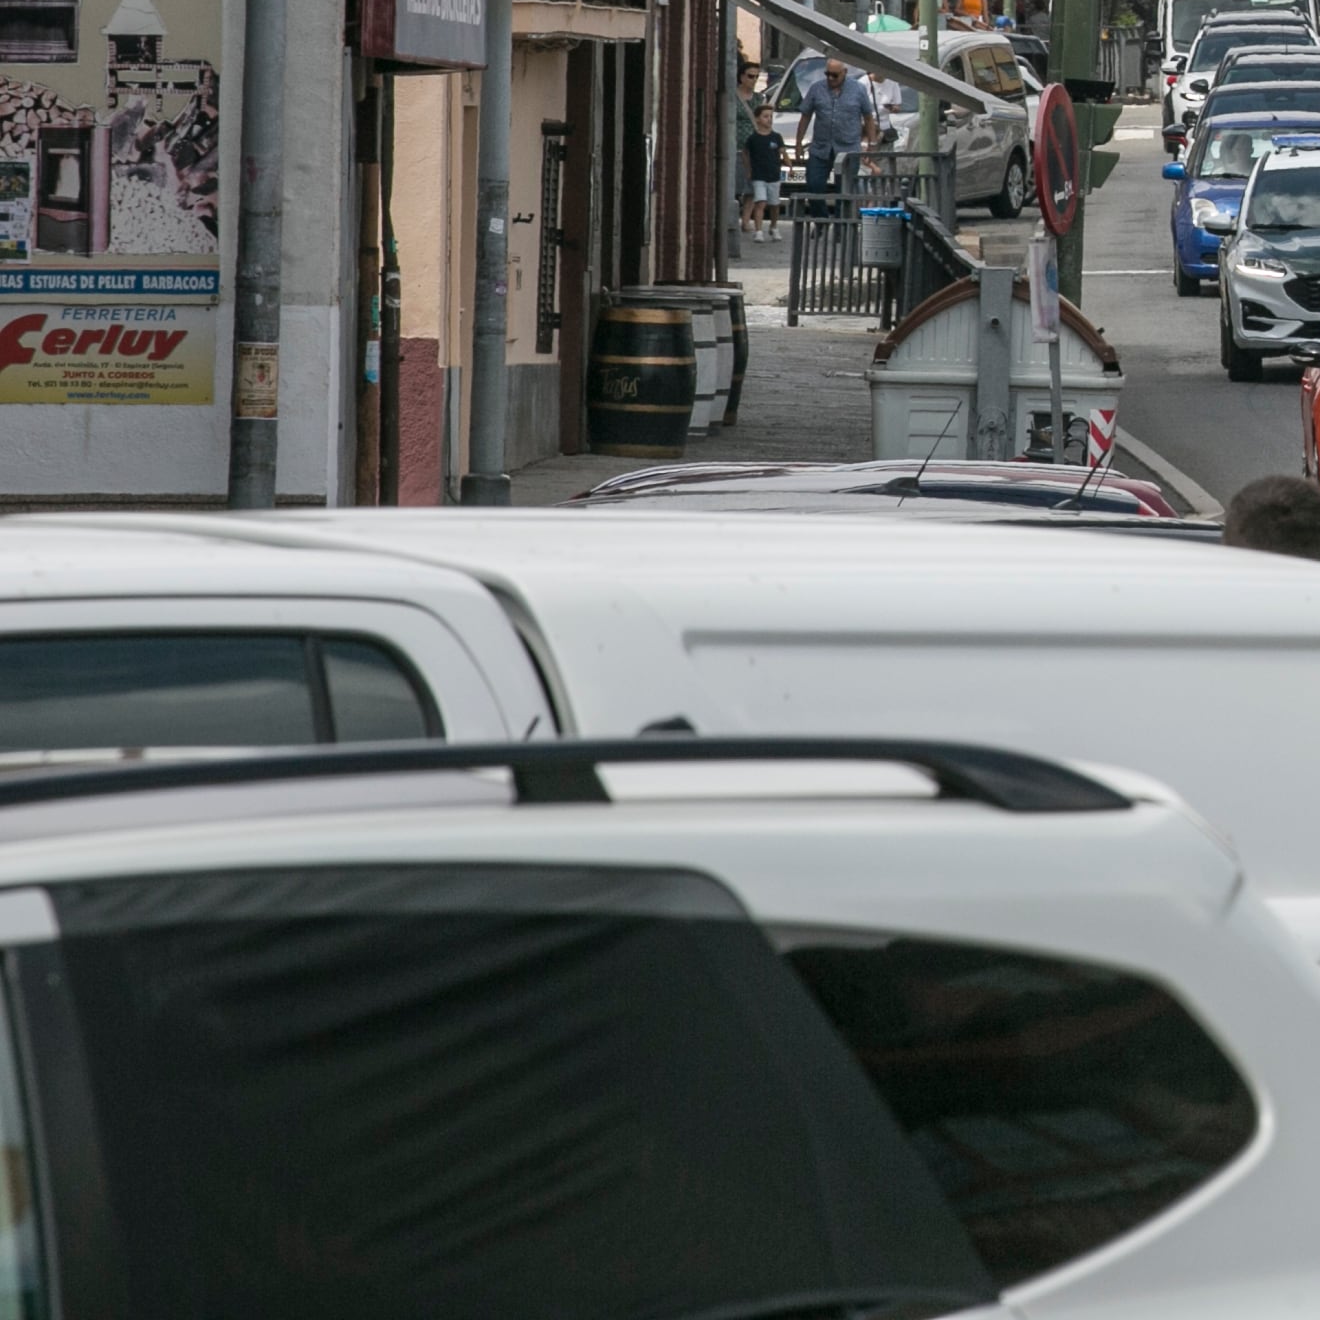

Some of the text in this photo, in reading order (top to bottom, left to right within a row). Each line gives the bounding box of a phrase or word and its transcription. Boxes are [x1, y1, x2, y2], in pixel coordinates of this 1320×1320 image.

[29, 274, 78, 290] ESTUFAS
[79, 275, 95, 289] DE
[98, 275, 137, 290] PELLET
[142, 275, 215, 291] BARBACOAS
[61, 307, 177, 321] FERRETERÍA
[62, 371, 155, 380] JUNTO A CORREOS
